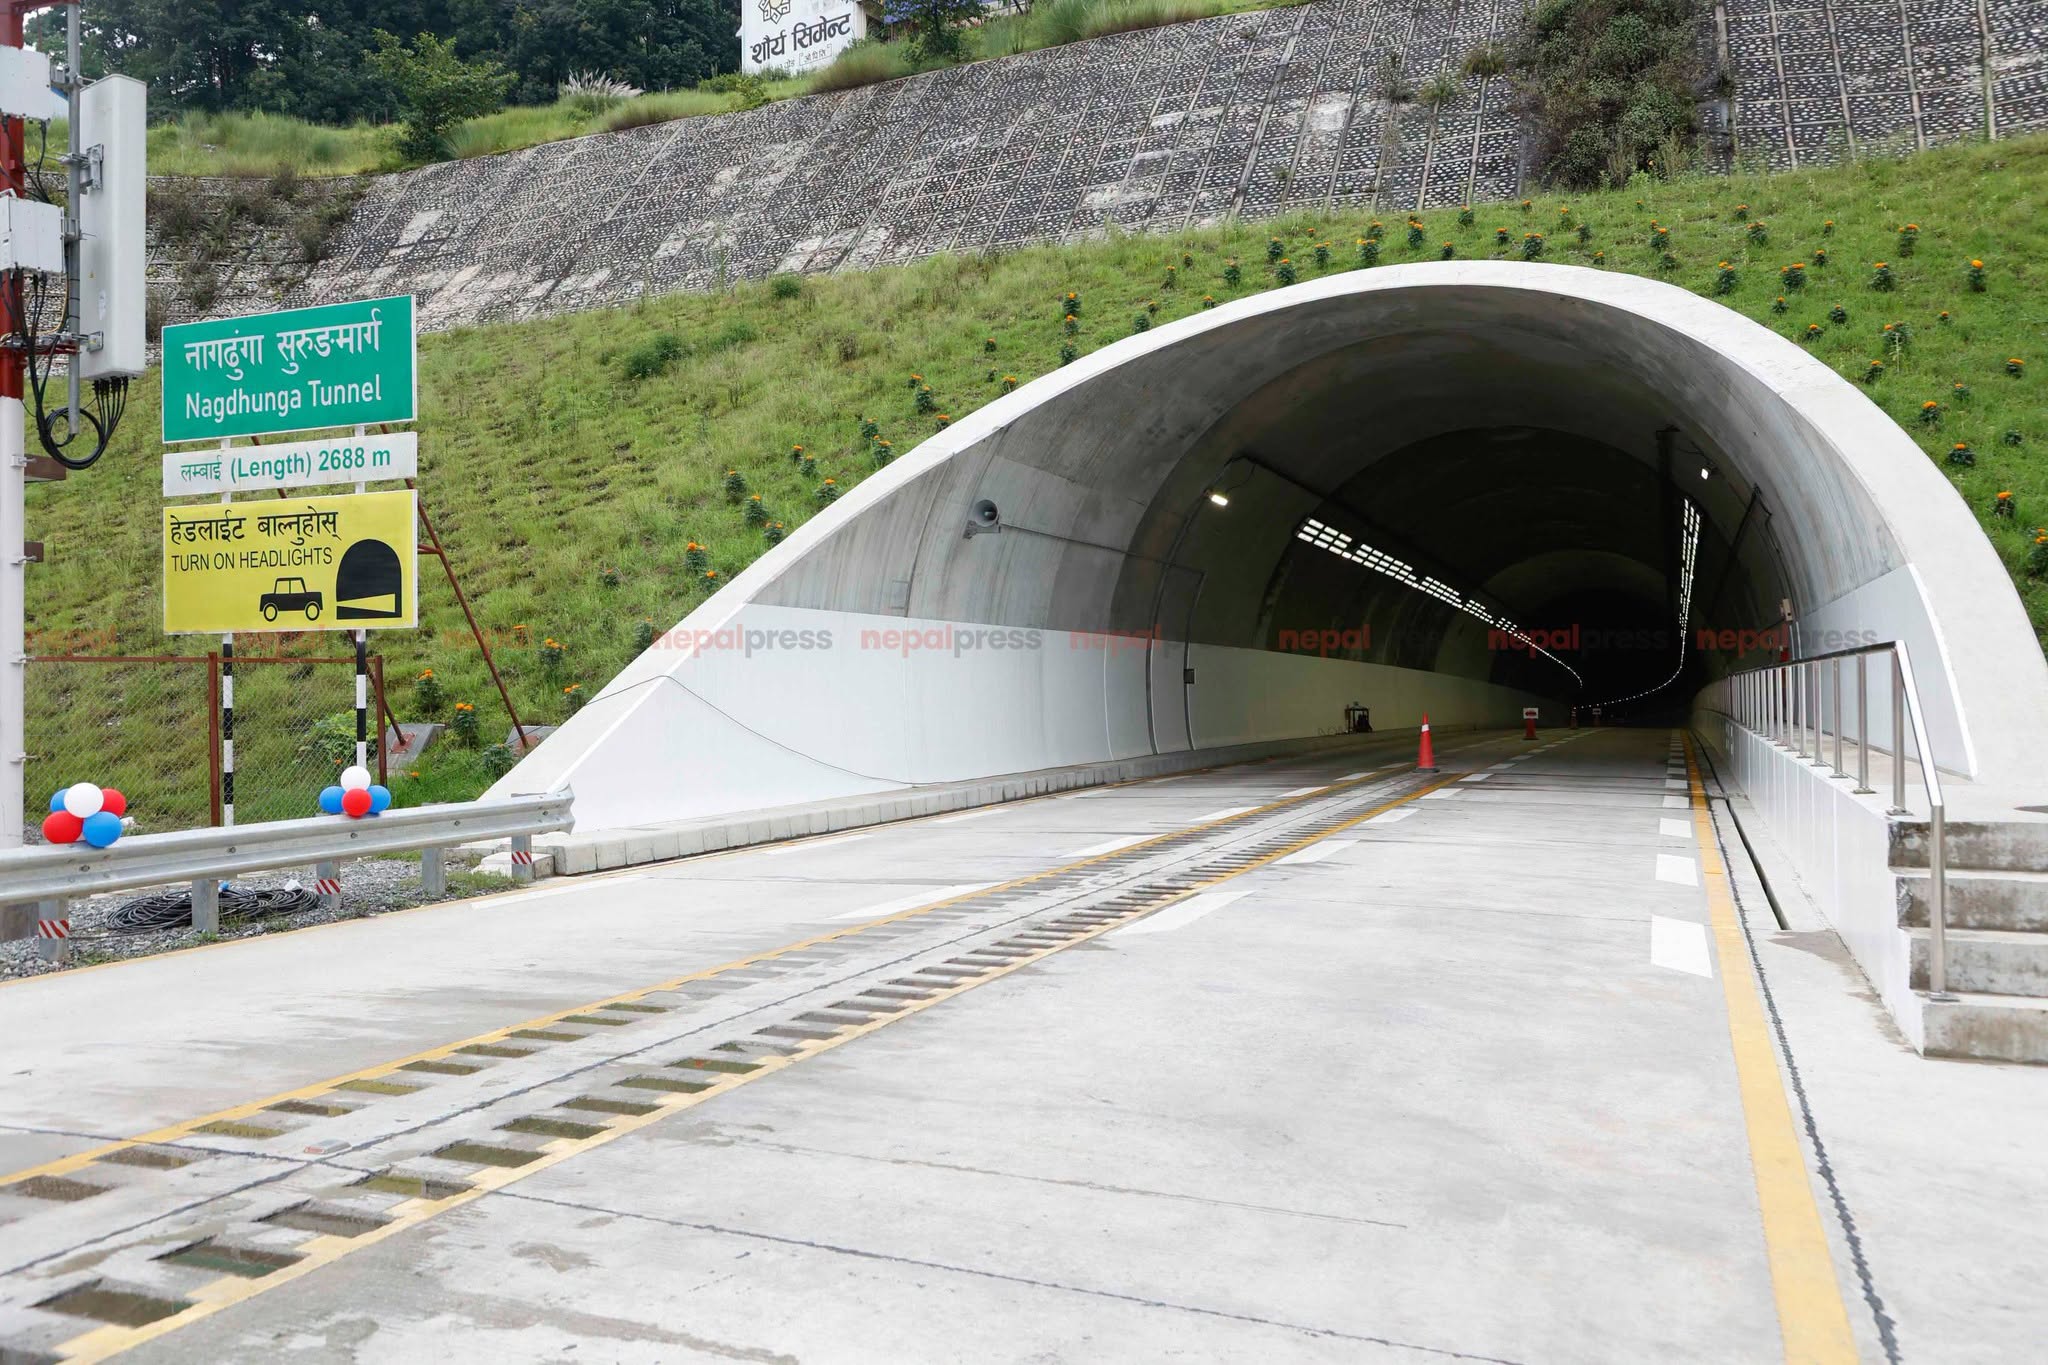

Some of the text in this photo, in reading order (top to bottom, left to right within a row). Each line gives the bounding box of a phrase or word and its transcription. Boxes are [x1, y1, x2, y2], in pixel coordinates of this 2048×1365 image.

[750, 29, 787, 64] शौर्य
[791, 13, 851, 51] सिमेन्ट
[184, 307, 383, 381] नागढुंगा सुरुङमार्ग
[186, 373, 382, 424] Nagdhunga Tunnel
[180, 447, 391, 483] लम्बाई (Length) 2688 m
[170, 505, 342, 545] हेडलाईट बाल्नुहोस्
[171, 546, 333, 572] TURN ON HEADLIGHTS
